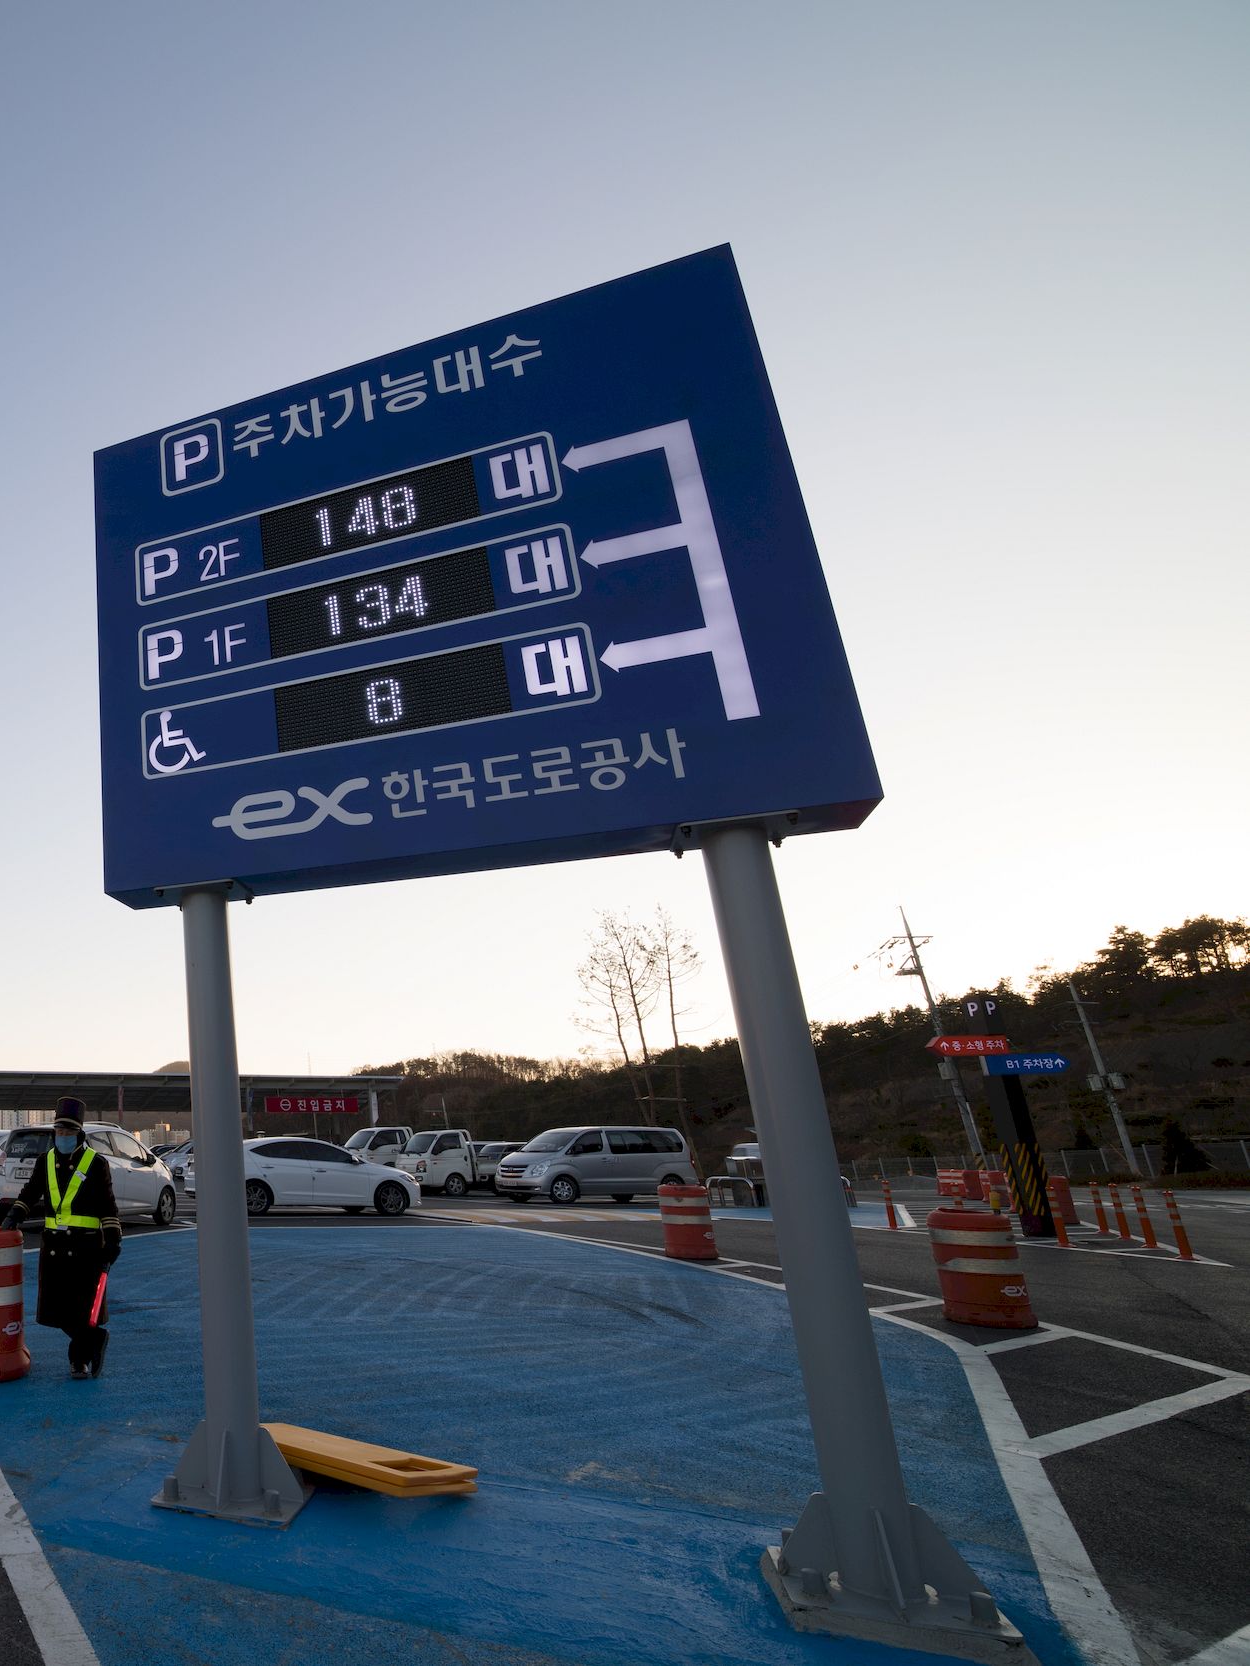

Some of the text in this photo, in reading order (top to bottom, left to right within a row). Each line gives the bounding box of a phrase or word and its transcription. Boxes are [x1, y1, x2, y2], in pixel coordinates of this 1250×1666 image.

[173, 334, 543, 482] P 주차가능대수
[488, 443, 551, 500] 대
[315, 486, 417, 547] 148
[143, 538, 241, 597] P 2F
[504, 535, 569, 594] 대
[324, 575, 429, 636] 134
[146, 623, 247, 681] P 1F
[521, 635, 588, 697] 대
[366, 678, 403, 724] 8
[211, 727, 687, 841] ex 한국도로공사
[966, 1002, 979, 1017] P
[984, 1000, 997, 1015] P
[986, 1040, 1005, 1050] 주차
[1006, 1058, 1054, 1069] B1 주차장
[297, 1099, 346, 1112] 진입금지
[1000, 1285, 1028, 1297] ex
